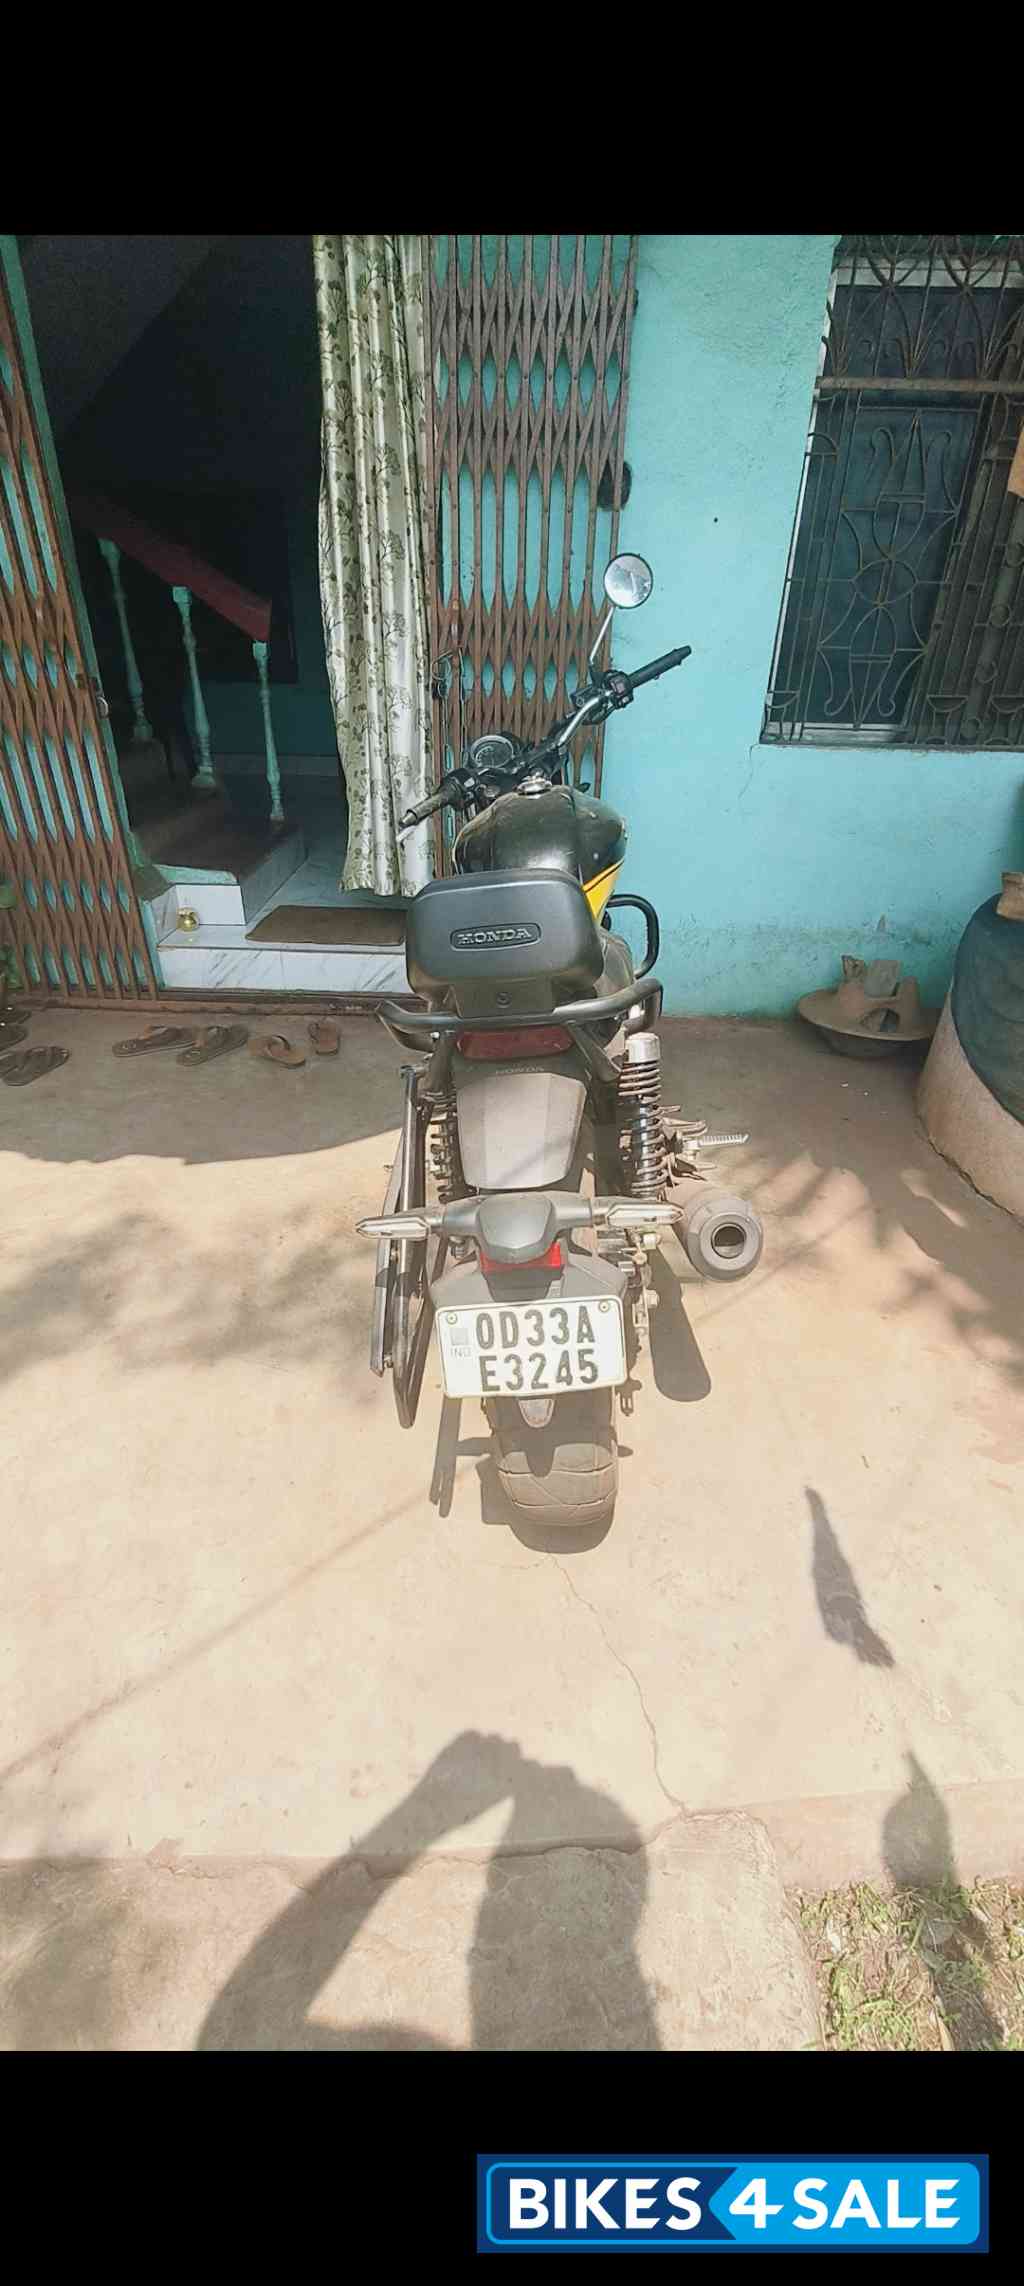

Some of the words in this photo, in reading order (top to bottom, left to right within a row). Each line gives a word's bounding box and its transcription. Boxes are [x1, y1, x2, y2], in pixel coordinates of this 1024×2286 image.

[456, 928, 532, 945] HONDA
[476, 1306, 596, 1350] OD33A
[479, 1349, 598, 1392] E3245
